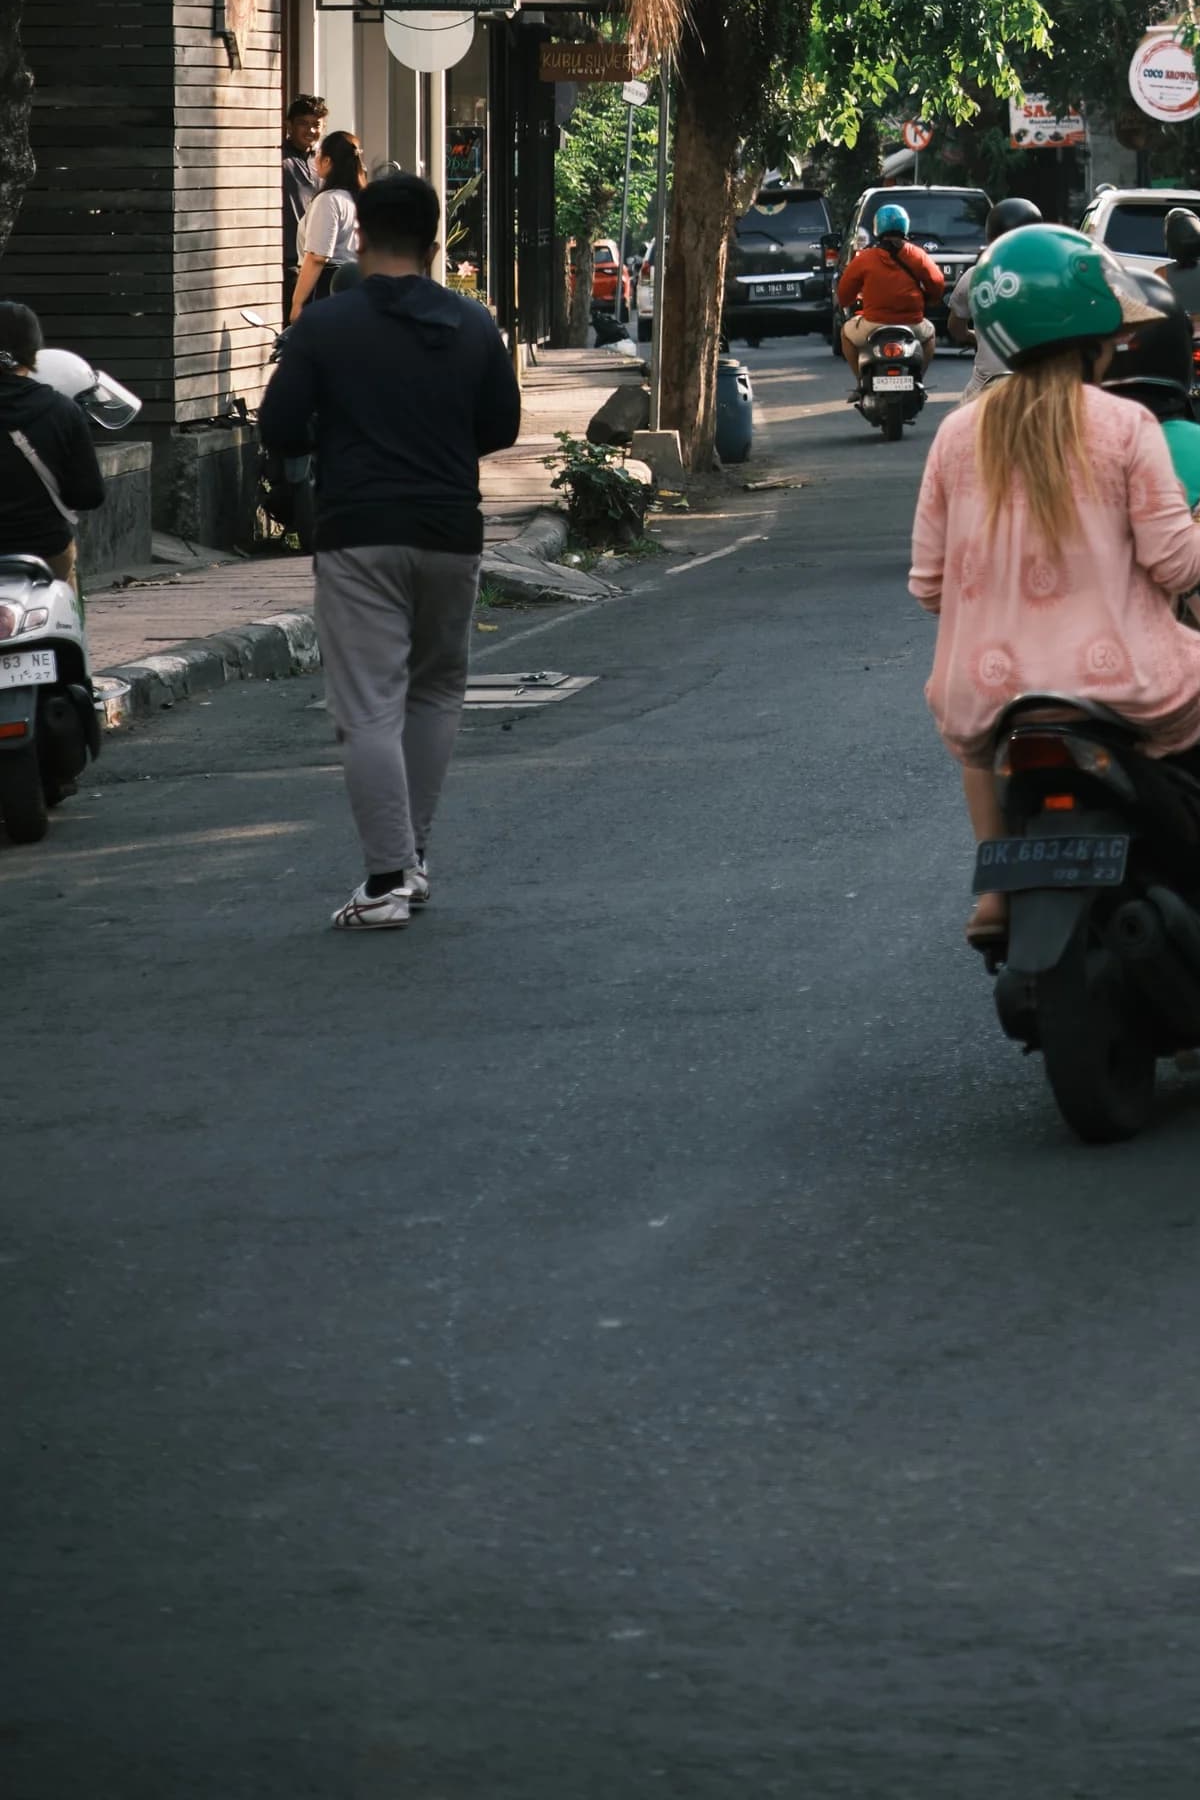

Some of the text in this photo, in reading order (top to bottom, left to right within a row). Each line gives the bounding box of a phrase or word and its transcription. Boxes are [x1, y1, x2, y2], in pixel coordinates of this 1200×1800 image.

[542, 52, 582, 68] KUBU
[1143, 68, 1163, 78] COCO
[0, 653, 50, 670] 63 NE
[981, 843, 1009, 866] DK
